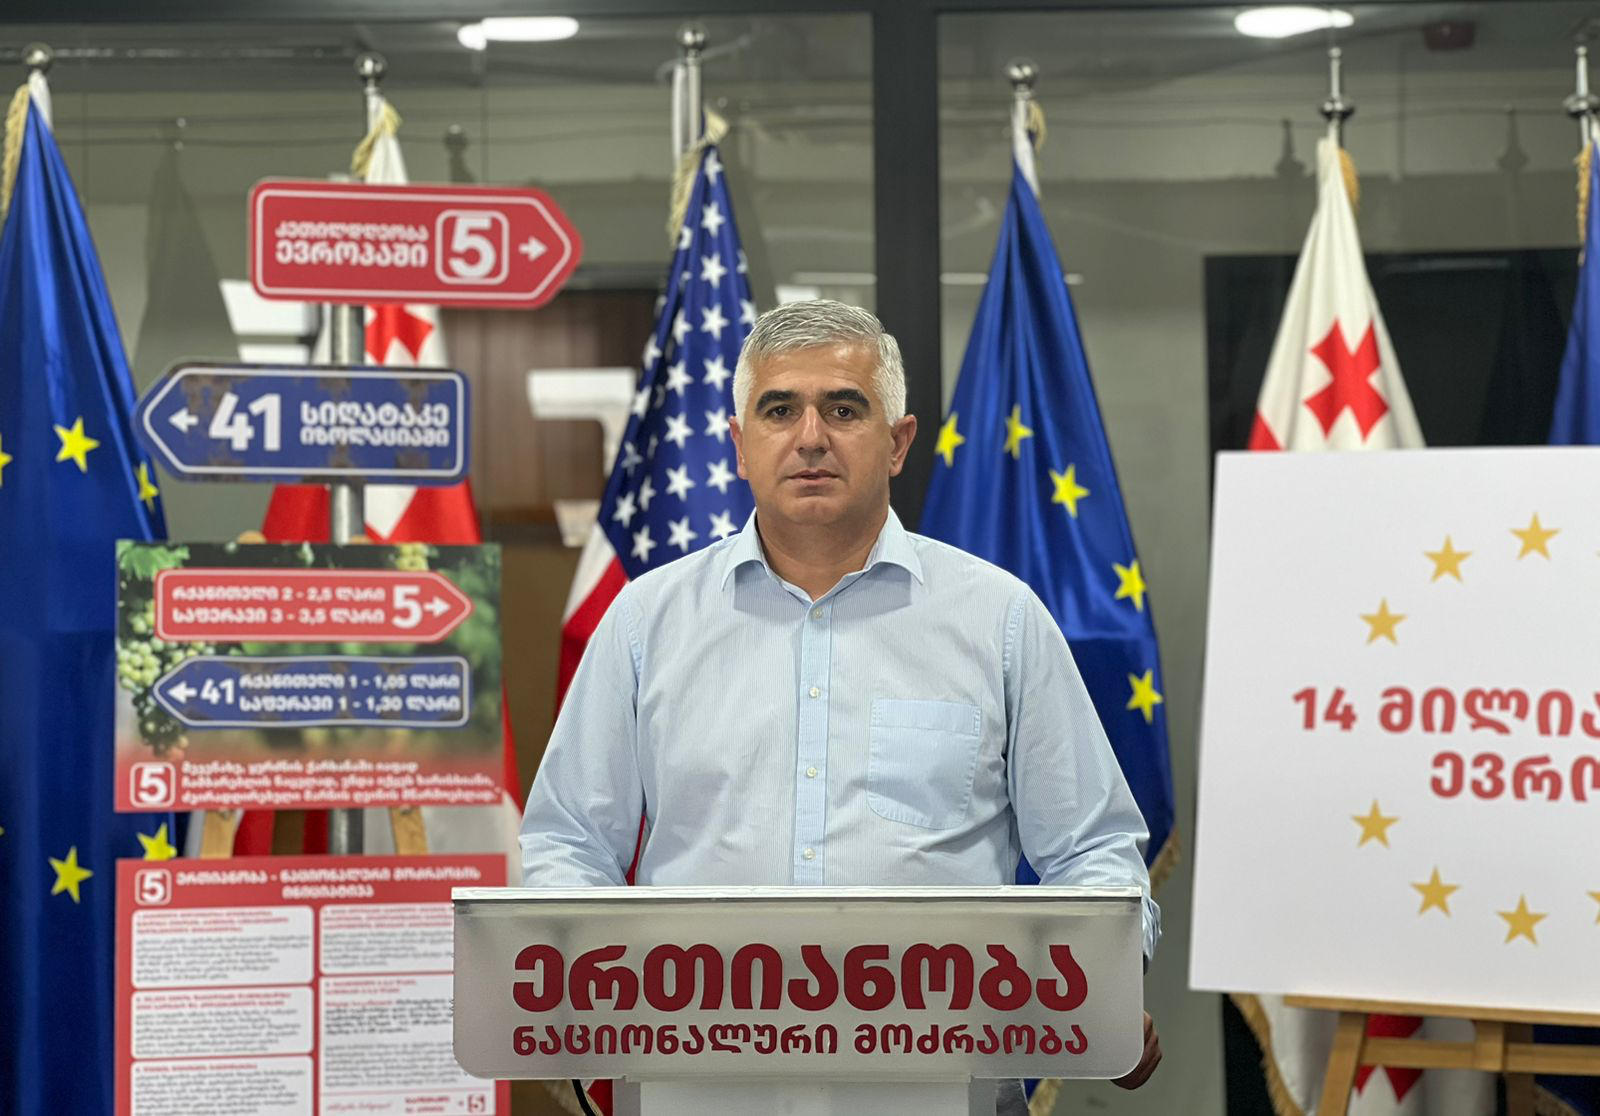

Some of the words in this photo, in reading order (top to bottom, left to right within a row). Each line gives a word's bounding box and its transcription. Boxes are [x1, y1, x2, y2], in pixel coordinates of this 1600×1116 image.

[275, 221, 429, 242] კეთილდღეობა
[275, 241, 429, 267] ევროპაში
[448, 215, 497, 280] 5
[208, 391, 281, 451] 41
[300, 401, 450, 428] სიღატაკე
[300, 426, 450, 448] იზოლაციაში
[282, 586, 293, 601] 2
[307, 587, 333, 602] 2,5
[335, 587, 386, 602] ლარი
[391, 584, 423, 629] 5
[271, 608, 283, 623] 3
[299, 608, 327, 625] 3,5
[329, 608, 385, 624] ლარი
[200, 677, 235, 705] 41
[349, 675, 358, 689] 1
[410, 674, 460, 690] ლარი
[338, 696, 348, 711] 1
[405, 696, 461, 711] ლარი
[1293, 687, 1358, 731] 14
[138, 765, 169, 803] 5
[142, 871, 166, 901] 5
[513, 943, 1088, 1012] ერთიანობა
[512, 1023, 839, 1056] ნაციონალური
[853, 1023, 1089, 1056] მოძრაობა
